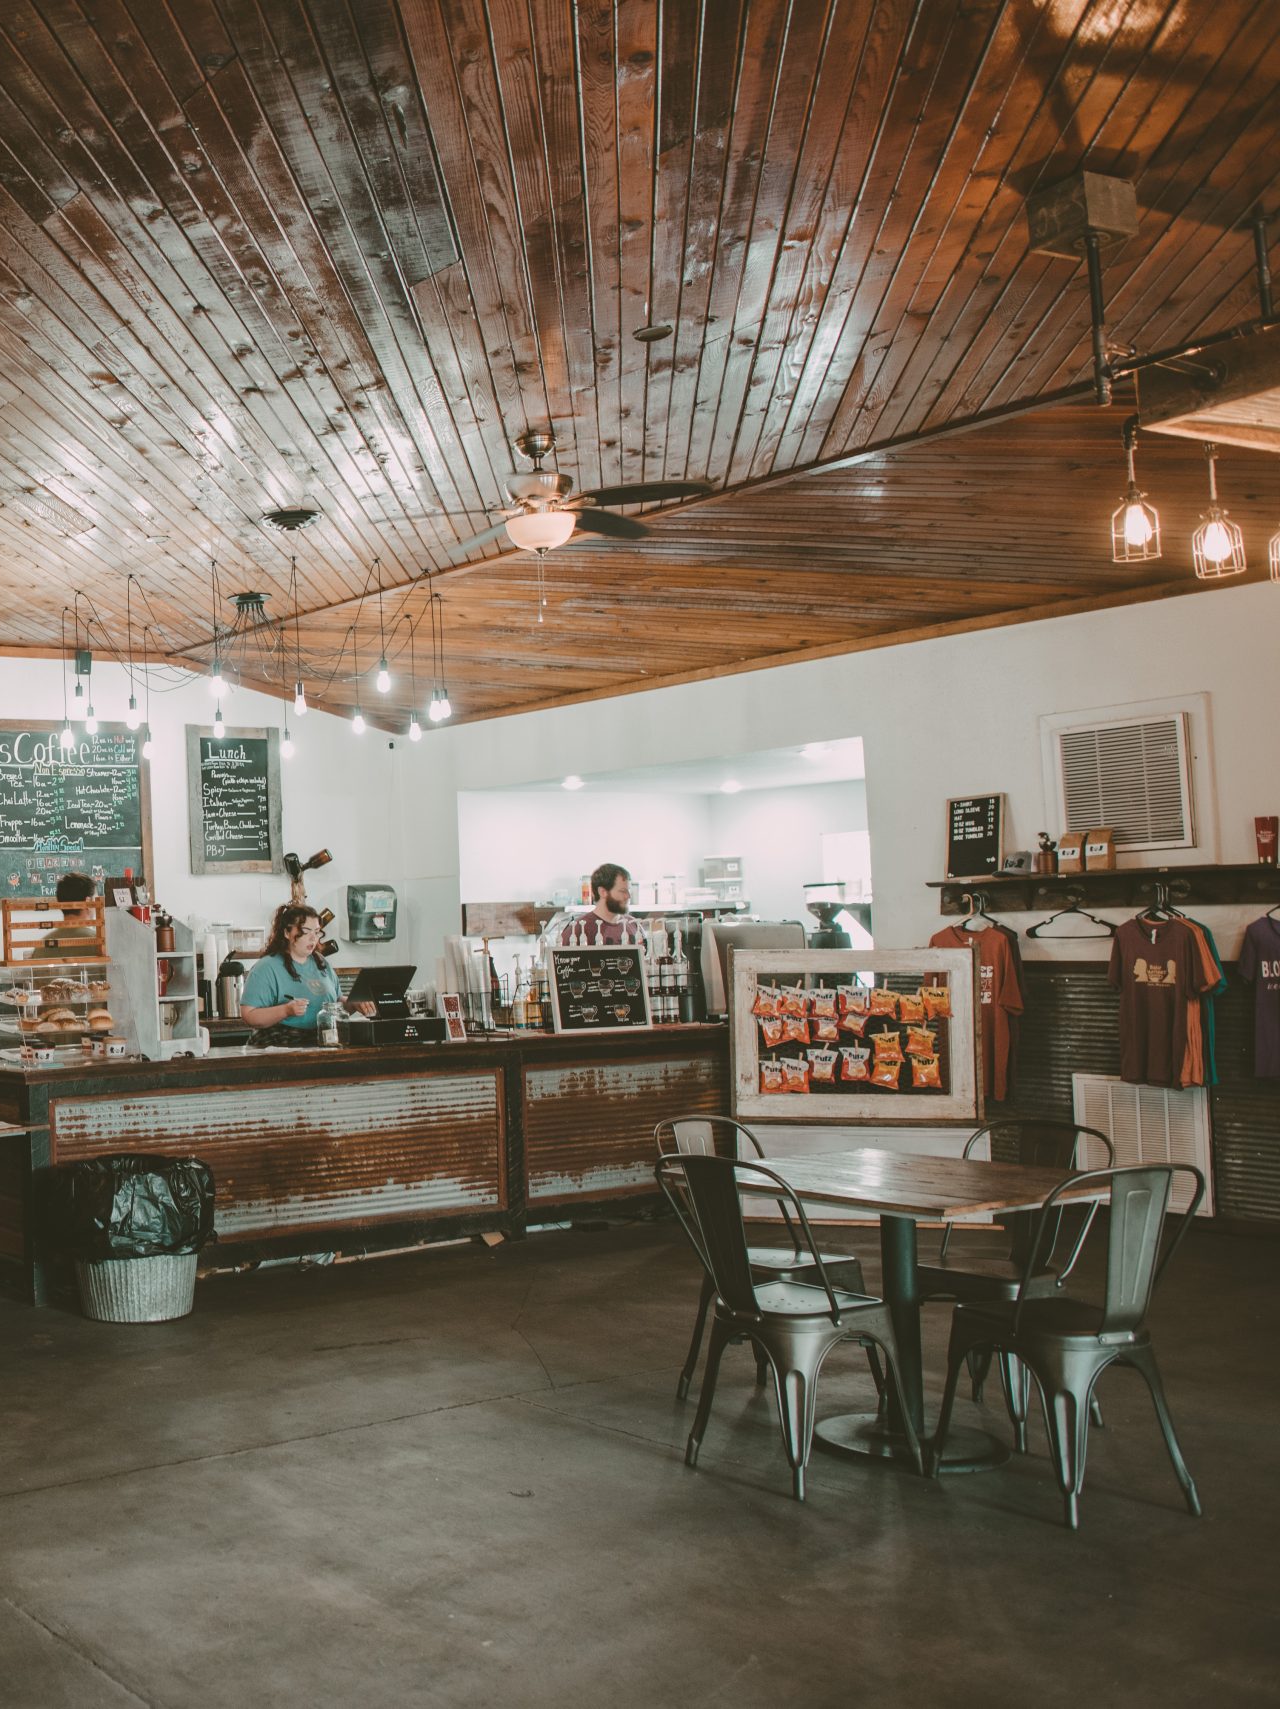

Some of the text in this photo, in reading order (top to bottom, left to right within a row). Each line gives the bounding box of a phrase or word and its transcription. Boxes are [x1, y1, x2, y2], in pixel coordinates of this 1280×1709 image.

[207, 742, 246, 759] Lunch
[203, 783, 223, 797] Spicy
[14, 791, 33, 806] Latte
[202, 797, 228, 807] Italian
[205, 830, 244, 841] Grilled Cheese
